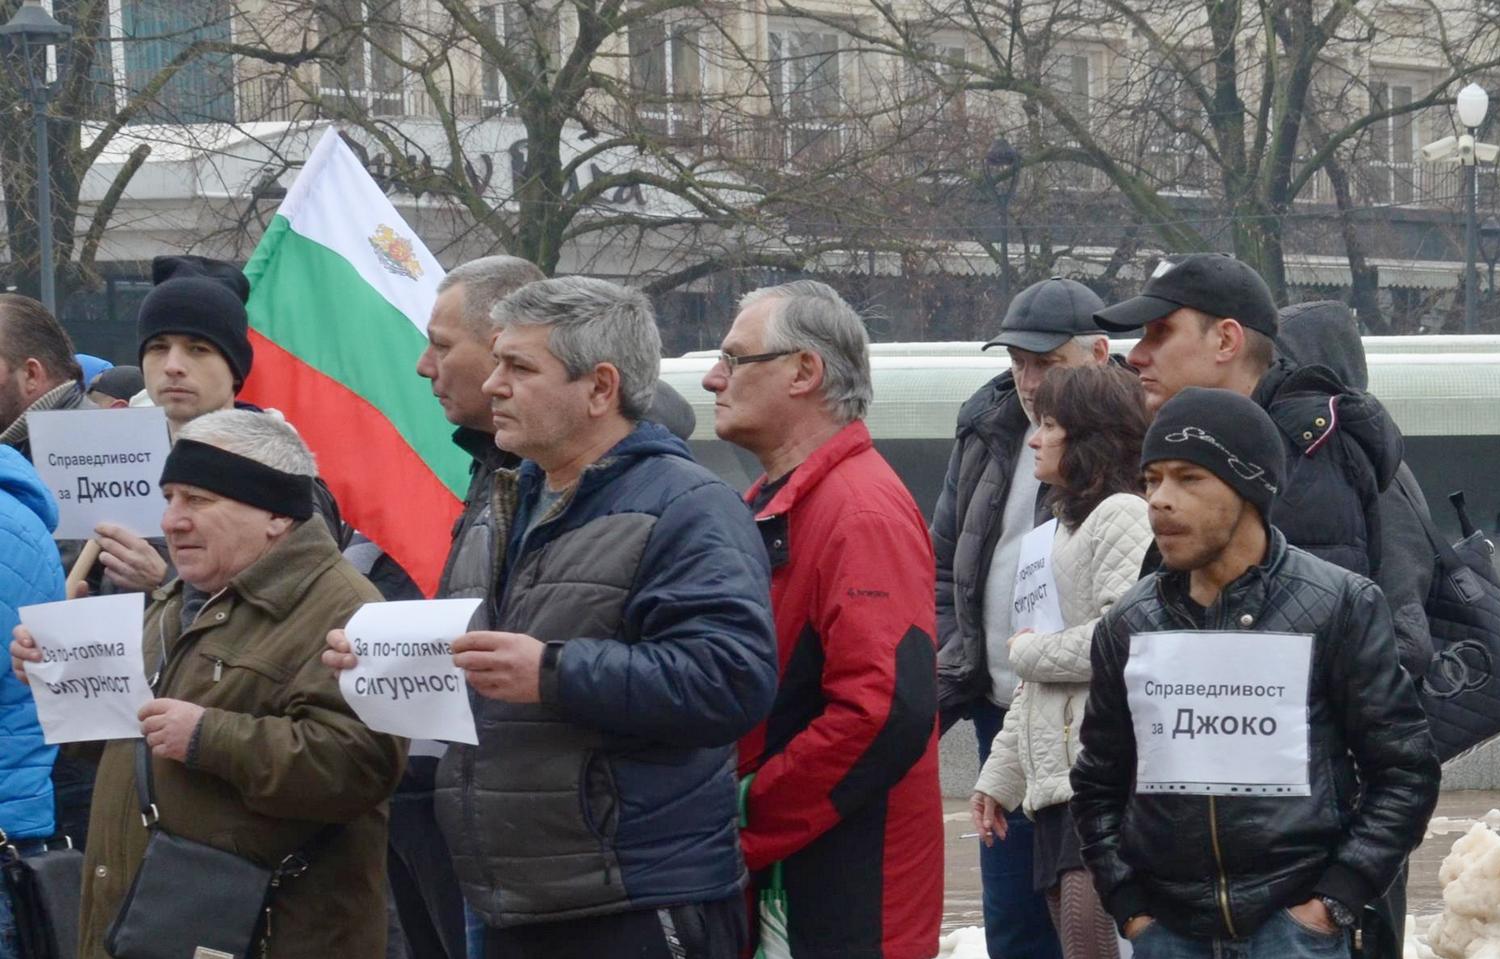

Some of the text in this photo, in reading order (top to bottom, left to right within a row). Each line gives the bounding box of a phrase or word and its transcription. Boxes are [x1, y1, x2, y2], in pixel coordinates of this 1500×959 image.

[48, 451, 151, 469] Справедливост
[58, 476, 150, 504] за Джоко
[354, 637, 368, 657] За
[1144, 680, 1285, 699] Справедливост
[1152, 708, 1277, 739] за Джоко
